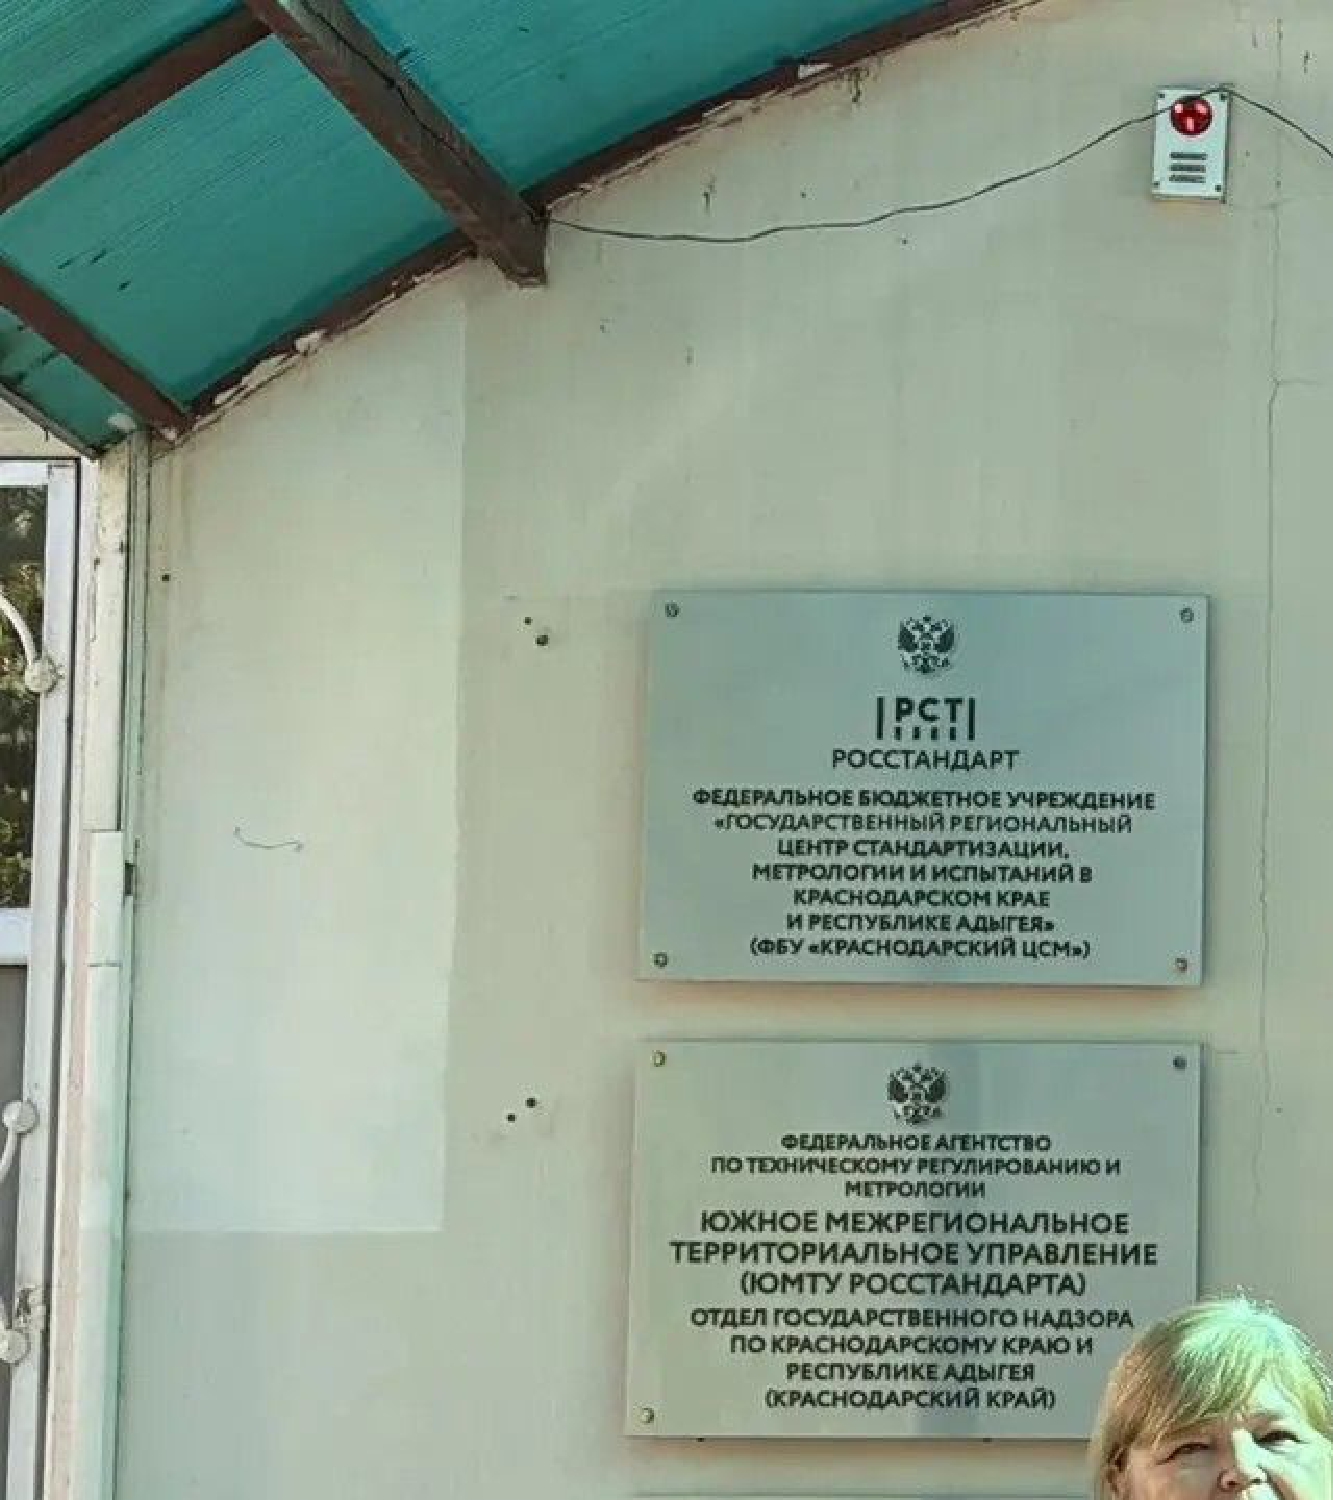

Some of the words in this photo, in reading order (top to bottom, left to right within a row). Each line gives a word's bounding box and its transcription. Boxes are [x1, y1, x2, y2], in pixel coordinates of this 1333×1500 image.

[833, 750, 1019, 771] РОССТАНДАРТ
[694, 788, 852, 808] ФЕДЕРАЛЬНОЕ
[860, 790, 1000, 808] БЮДЖЕТНОЕ
[1006, 792, 1154, 810] УЧРЕЖДЕНИЕ
[715, 813, 944, 831] «ГОСУДАРСТВЕННЫЙ
[950, 815, 1131, 833] РЕГИОНАЛЬНЫЙ
[775, 840, 848, 856] ЦЕНТР
[752, 863, 904, 881] МЕТРОЛОГИИ
[910, 865, 925, 881] И
[933, 863, 1073, 883] ИСПЫТАНИЙ
[1079, 867, 1092, 883] В
[794, 890, 990, 908] КРАСНОДАРСКОМ
[998, 890, 1050, 906] КРАЕ
[787, 915, 802, 929] И
[808, 915, 950, 931] РЕСПУБЛИКЕ
[956, 915, 1054, 933] АДЫГЕЯ»
[750, 938, 804, 956] (ФБУ
[808, 938, 1015, 958] «КРАСНОДАРСКИЙ
[1023, 940, 1090, 958] ЦСМ»)
[781, 1133, 931, 1152] ФЕДЕРАЛЬНОЕ
[935, 1135, 1050, 1152] АГЕНТСТВО
[712, 1156, 742, 1173] ПО
[746, 1158, 912, 1173] ТЕХНИЧЕСКОМУ
[917, 1158, 1100, 1175] РЕГУЛИРОВАНИЮ
[1106, 1160, 1119, 1175] И
[846, 1181, 985, 1198] МЕТРОЛОГИИ
[702, 1210, 817, 1233] ЮЖНОЕ
[825, 1213, 1127, 1233] МЕЖРЕГИОНАЛЬНОЕ
[671, 1242, 958, 1265] ТЕРРИТОРИАЛЬНОЕ
[967, 1244, 1156, 1265] УПРАВЛЕНИЕ
[742, 1271, 842, 1294] (ЮМТУ
[850, 1273, 1085, 1298] РОССТАНДАРТА)
[692, 1308, 767, 1329] ОТДЕЛ
[775, 1308, 1017, 1327] ГОСУДАРСТВЕННОГО
[1023, 1310, 1133, 1329] НАДЗОРА
[731, 1335, 767, 1352] ПО
[771, 1335, 996, 1356] КРАСНОДАРСКОМУ
[1002, 1338, 1071, 1354] КРАЮ
[1077, 1338, 1092, 1354] И
[787, 1363, 940, 1381] РЕСПУБЛИКЕ
[944, 1363, 1033, 1383] АДЫГЕЯ
[765, 1388, 979, 1408] (КРАСНОДАРСКИЙ
[987, 1388, 1056, 1408] КРАЙ)
